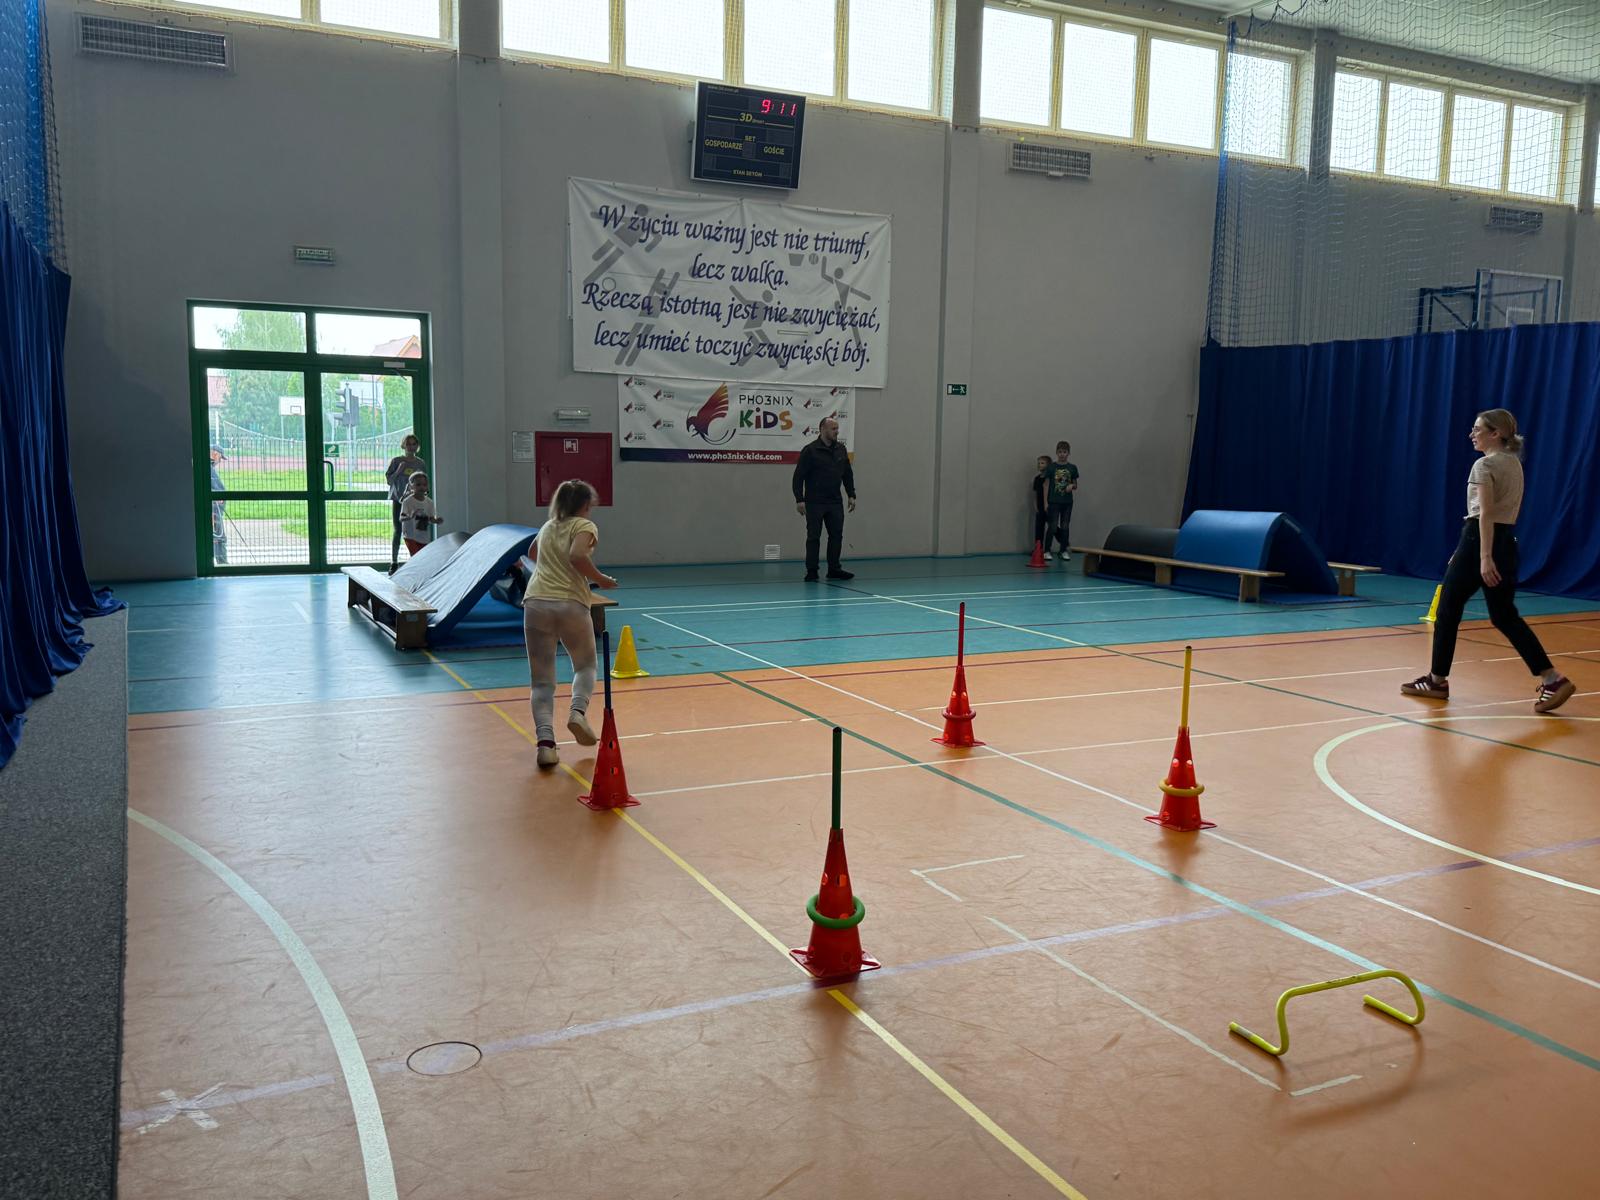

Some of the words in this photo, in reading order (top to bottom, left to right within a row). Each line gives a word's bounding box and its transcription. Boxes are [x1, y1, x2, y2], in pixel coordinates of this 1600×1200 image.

[704, 139, 743, 150] GOSPODARZE
[763, 145, 785, 155] GOŚCIE
[599, 204, 626, 229] W
[628, 211, 680, 243] życiu
[684, 220, 747, 253] ważny
[746, 223, 779, 253] jest
[784, 228, 809, 251] nie
[812, 232, 871, 264] triumf,
[691, 253, 725, 281] lecz
[582, 282, 653, 313] Rzeczą
[659, 291, 722, 323] istotną
[722, 299, 759, 328] jest
[763, 302, 787, 322] nie
[790, 306, 881, 333] zwyciężać,
[594, 321, 630, 348] lecz
[636, 329, 690, 352] umieć
[695, 335, 752, 365] toczyć
[755, 339, 839, 368] zwycięski
[841, 342, 871, 372] bój.
[688, 450, 783, 462] www.pho3nix-kids.com
